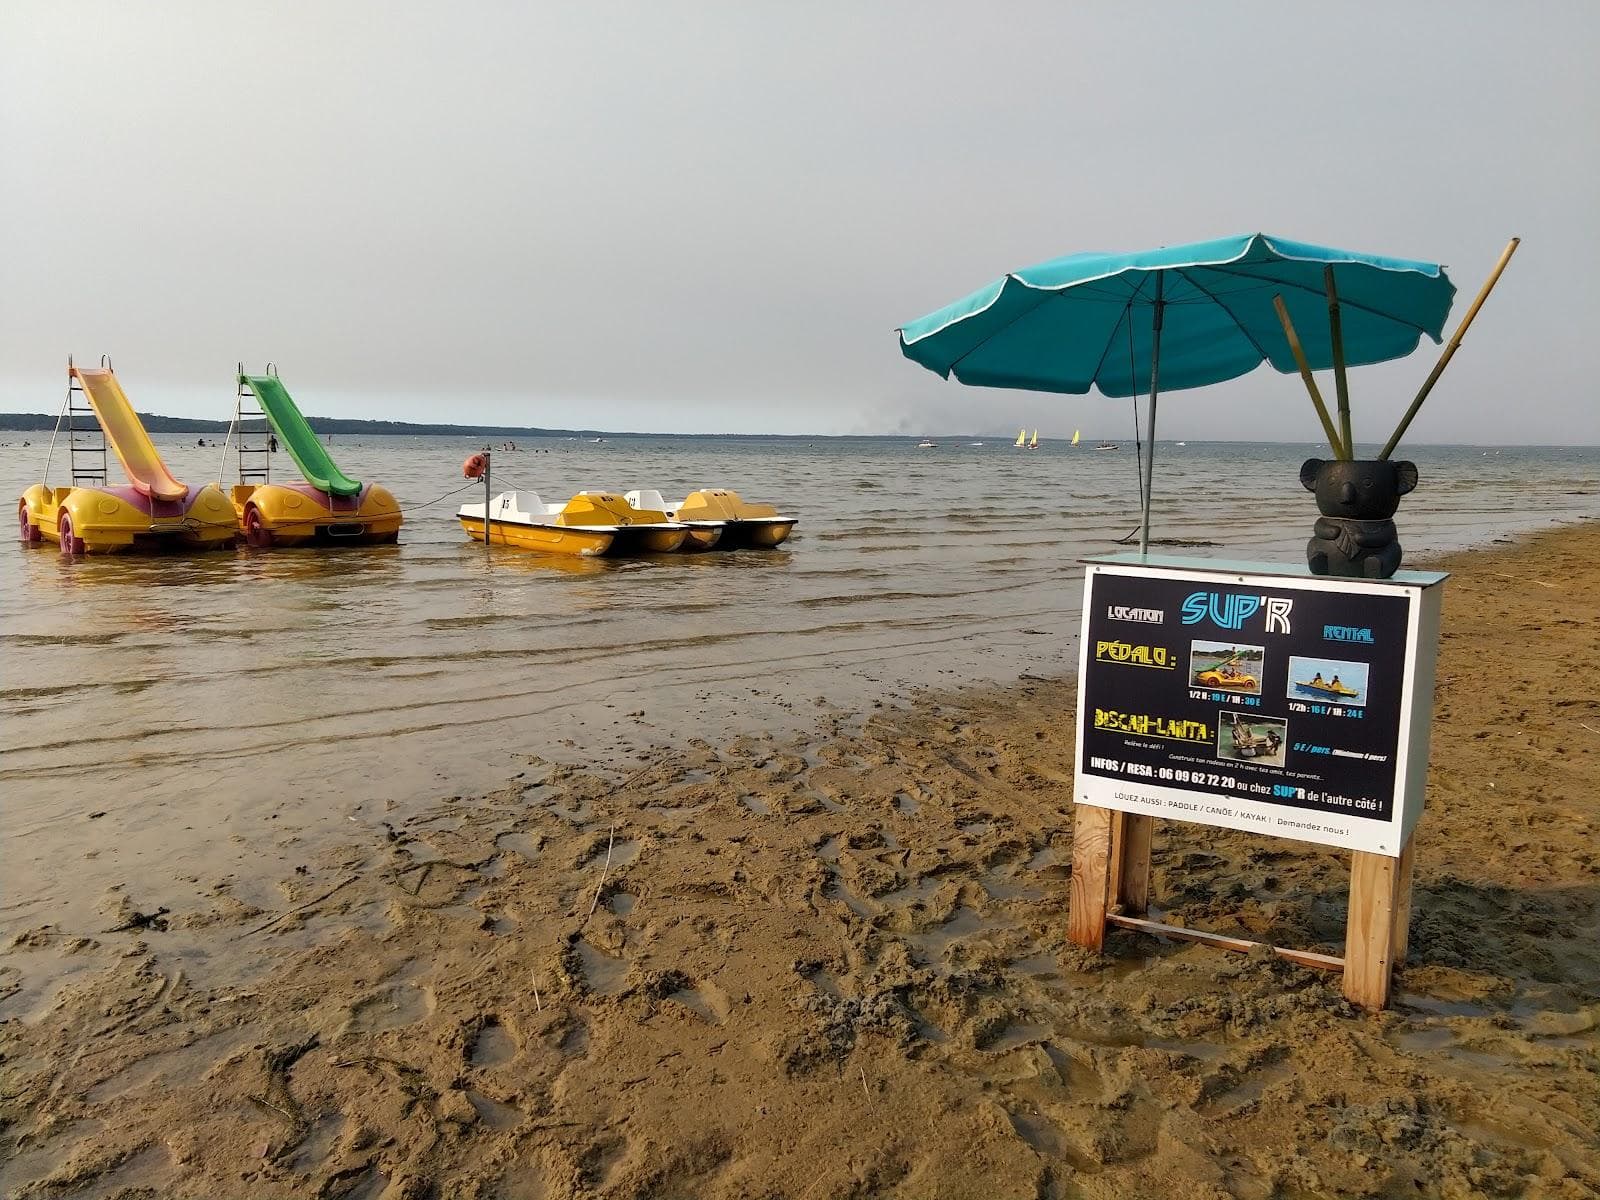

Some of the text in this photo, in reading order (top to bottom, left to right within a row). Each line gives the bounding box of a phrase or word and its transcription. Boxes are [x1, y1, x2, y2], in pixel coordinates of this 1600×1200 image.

[1107, 605, 1164, 623] LOCATION
[1181, 592, 1294, 635] SUP'R
[1323, 625, 1374, 642] RENTAL
[1096, 640, 1167, 666] PÉDALO
[1189, 690, 1201, 700] 1/2
[1346, 709, 1357, 718] 24
[1090, 756, 1119, 772] INFOS
[1127, 763, 1153, 778] RESA
[1159, 767, 1174, 780] 06
[1174, 769, 1190, 782] 09
[1191, 771, 1206, 784] 62
[1206, 773, 1220, 787] 72
[1220, 776, 1236, 789] 20
[1237, 781, 1248, 791] ou
[1250, 781, 1272, 795] chez
[1273, 784, 1306, 800] SUP'R
[1307, 790, 1319, 802] de
[1321, 791, 1353, 807] l'autre
[1355, 797, 1377, 811] côté
[1114, 792, 1138, 803] LOUEZ
[1140, 796, 1162, 807] AUSSI
[1168, 800, 1198, 812] PADDLE
[1240, 811, 1267, 823] KAYAK
[1277, 818, 1321, 831] Demandez
[1323, 826, 1344, 835] nous
